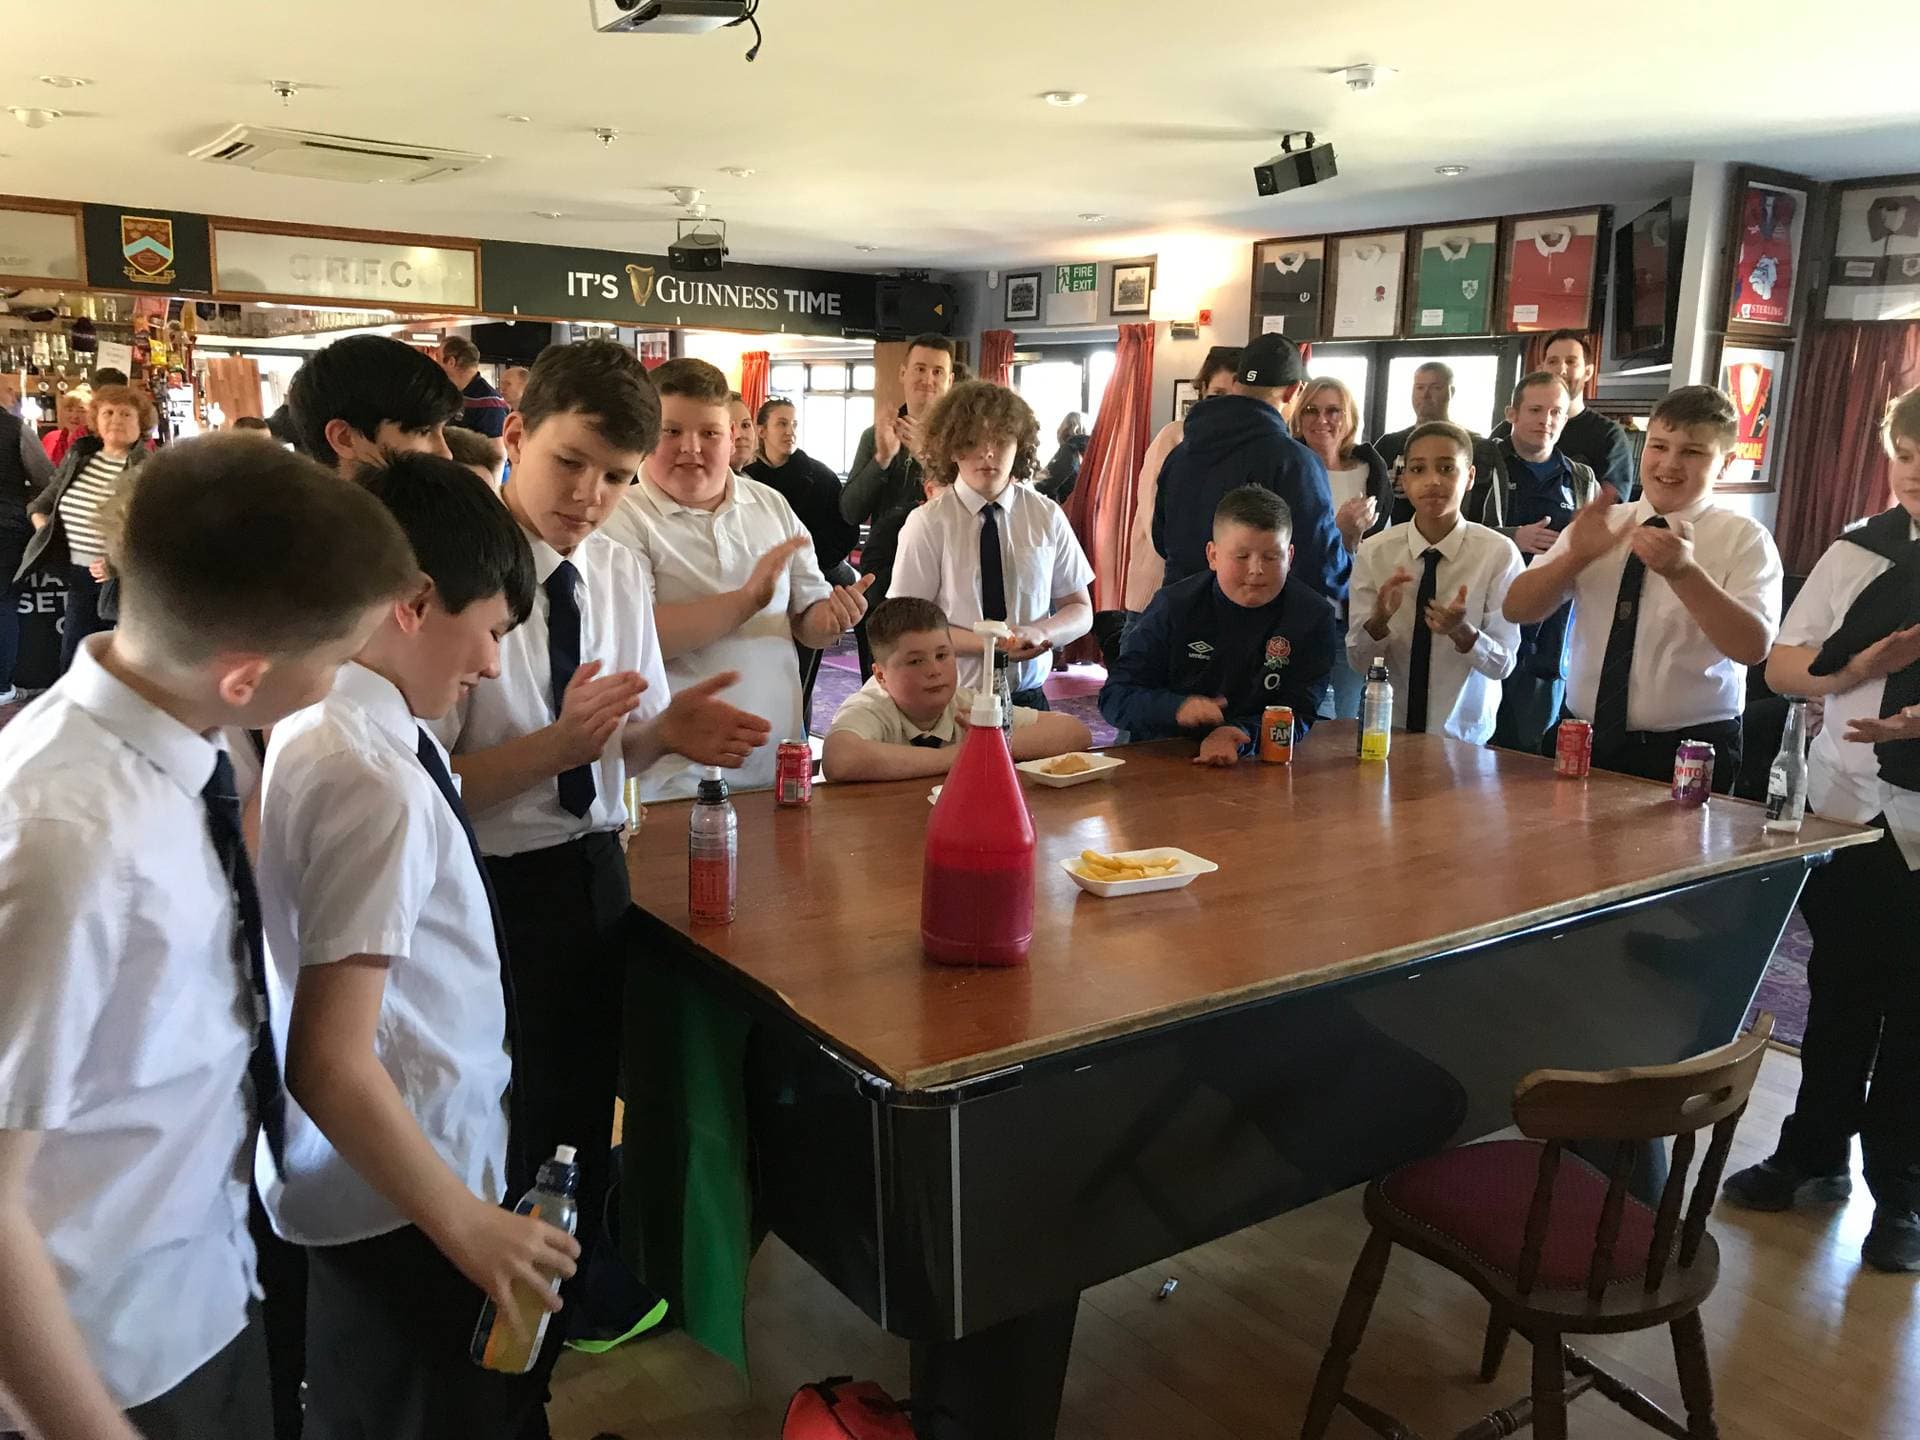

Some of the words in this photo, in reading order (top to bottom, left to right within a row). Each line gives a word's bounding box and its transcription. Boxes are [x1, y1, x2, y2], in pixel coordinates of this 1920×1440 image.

[1073, 266, 1093, 278] FIRE
[1073, 280, 1093, 291] EXIT
[656, 275, 779, 310] GUINNESS
[784, 289, 841, 316] TIME
[1751, 304, 1784, 316] STERLING
